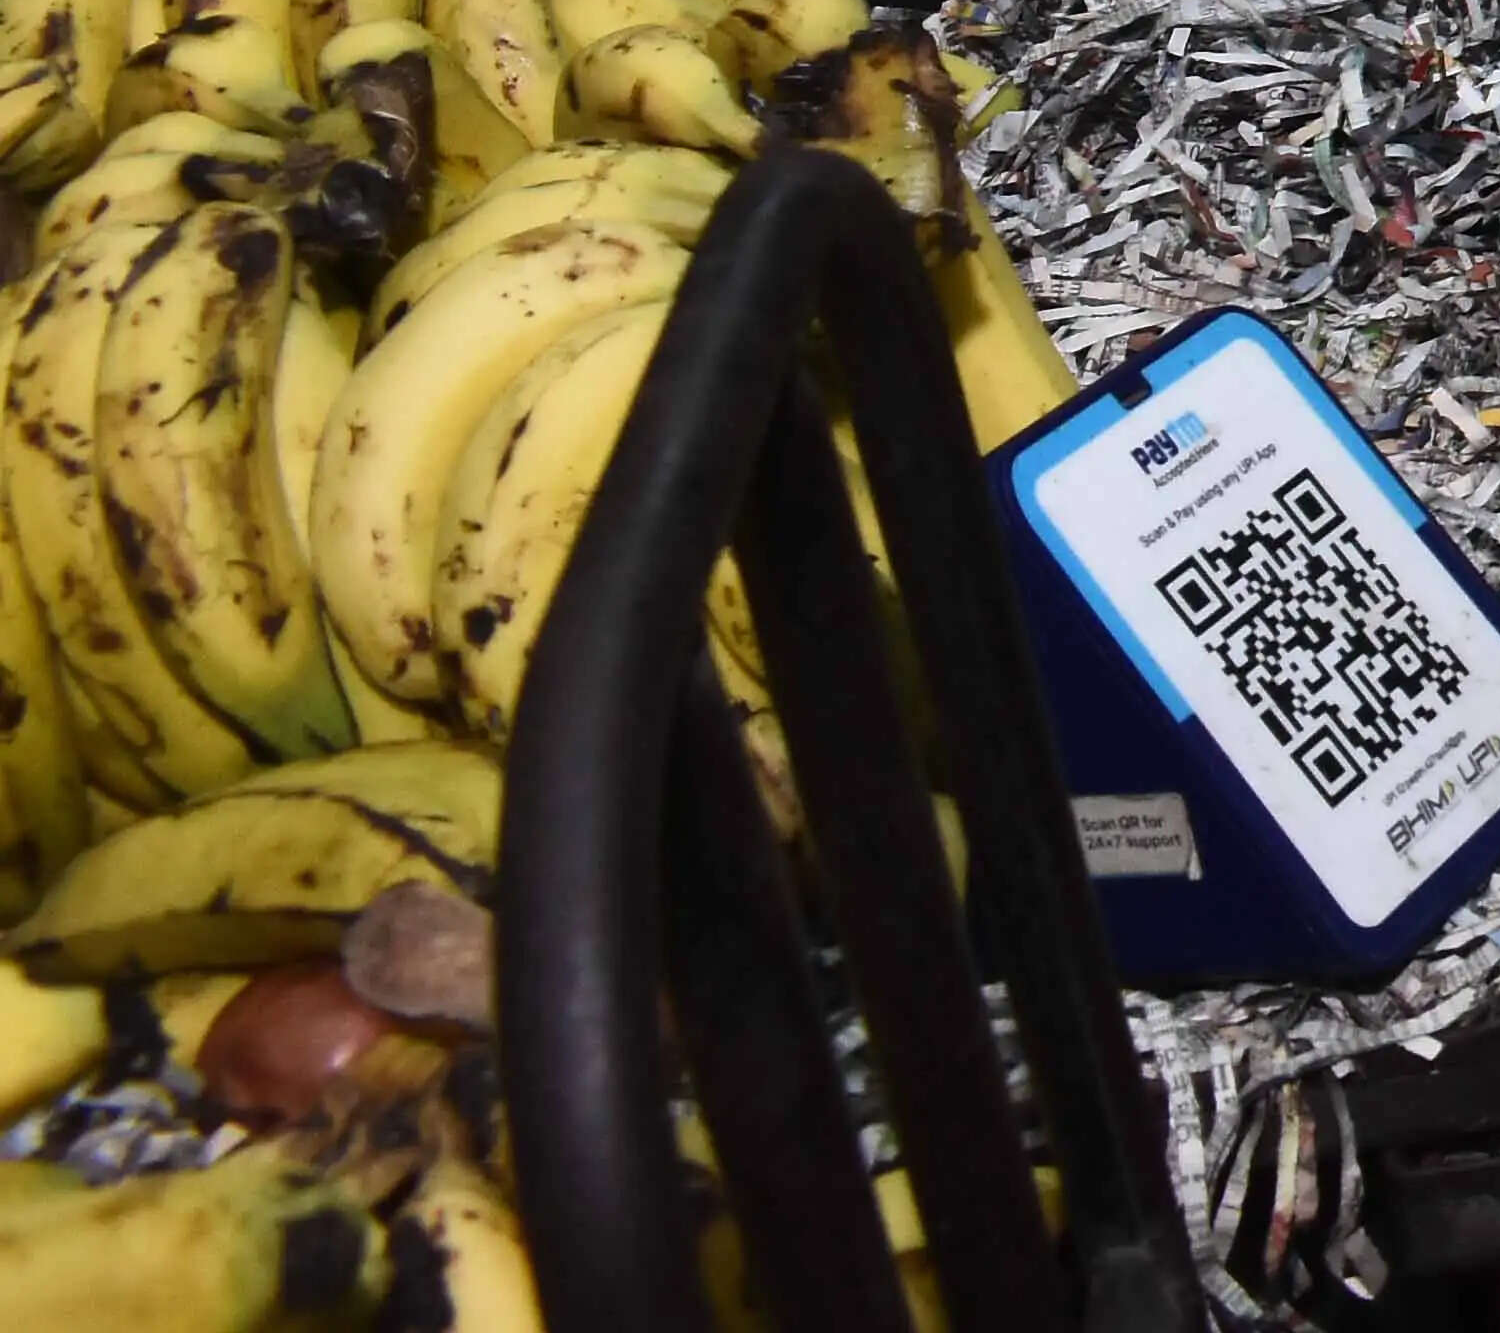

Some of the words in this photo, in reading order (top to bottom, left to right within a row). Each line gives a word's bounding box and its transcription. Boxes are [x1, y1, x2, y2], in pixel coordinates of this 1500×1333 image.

[1153, 453, 1199, 488] Accepted
[1194, 439, 1219, 459] Here
[1139, 525, 1168, 548] Scan
[1165, 517, 1176, 529] &
[1173, 505, 1195, 522] Pay
[1194, 484, 1224, 508] using
[1221, 472, 1240, 488] any
[1238, 457, 1257, 474] UPI
[1255, 443, 1277, 462] App
[1386, 786, 1450, 853] BHIM
[1457, 738, 1499, 785] UPI
[1080, 817, 1117, 832] Scan
[1118, 814, 1140, 830] QR
[1142, 814, 1165, 830] for
[1126, 833, 1182, 851] support
